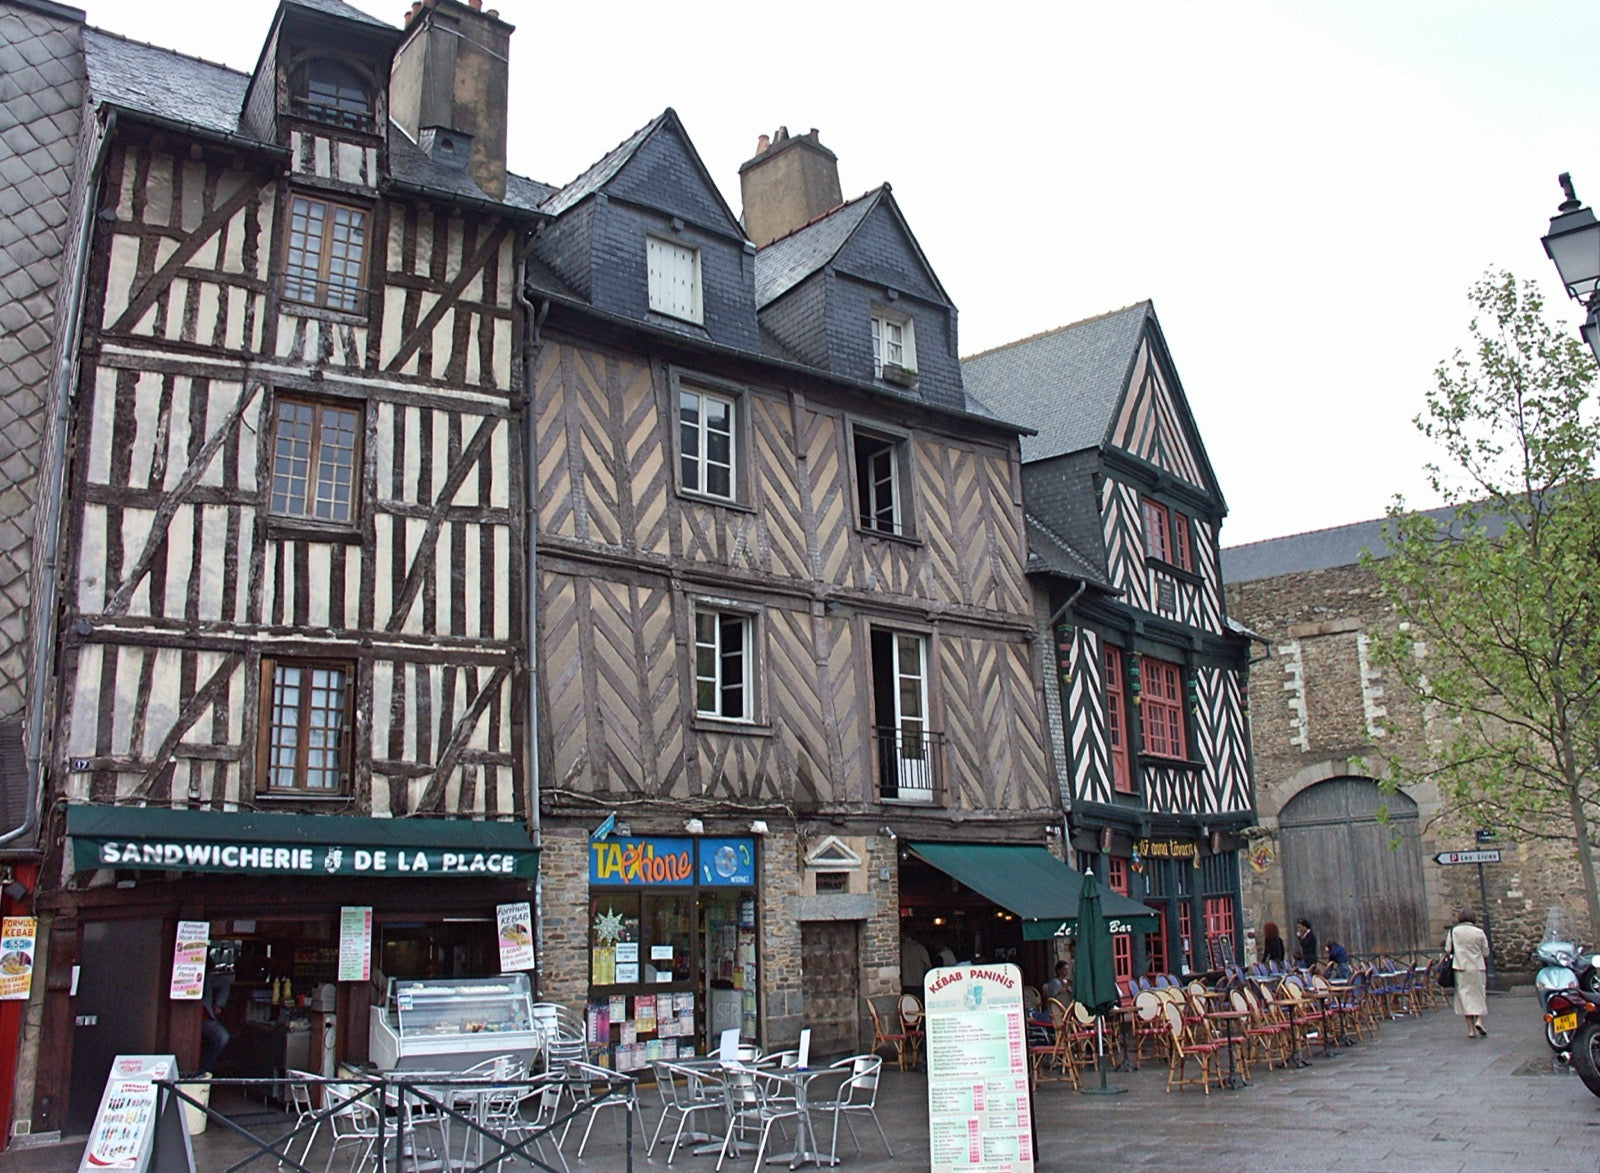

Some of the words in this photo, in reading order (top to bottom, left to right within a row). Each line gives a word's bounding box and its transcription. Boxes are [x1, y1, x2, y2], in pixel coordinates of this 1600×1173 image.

[77, 760, 88, 769] 17
[103, 842, 313, 869] SANDWICHERIE
[354, 850, 387, 871] DE
[398, 851, 429, 871] LA
[442, 853, 514, 873] PLACE
[498, 904, 528, 915] Formule
[3, 919, 36, 928] FORMULE
[501, 913, 529, 924] KEBAB
[5, 928, 34, 937] KEBAB
[1053, 922, 1071, 936] Le
[1109, 920, 1132, 933] Bar
[929, 971, 963, 994] KEBAB
[970, 969, 1015, 989] PANINIS
[716, 1002, 739, 1022] SFR
